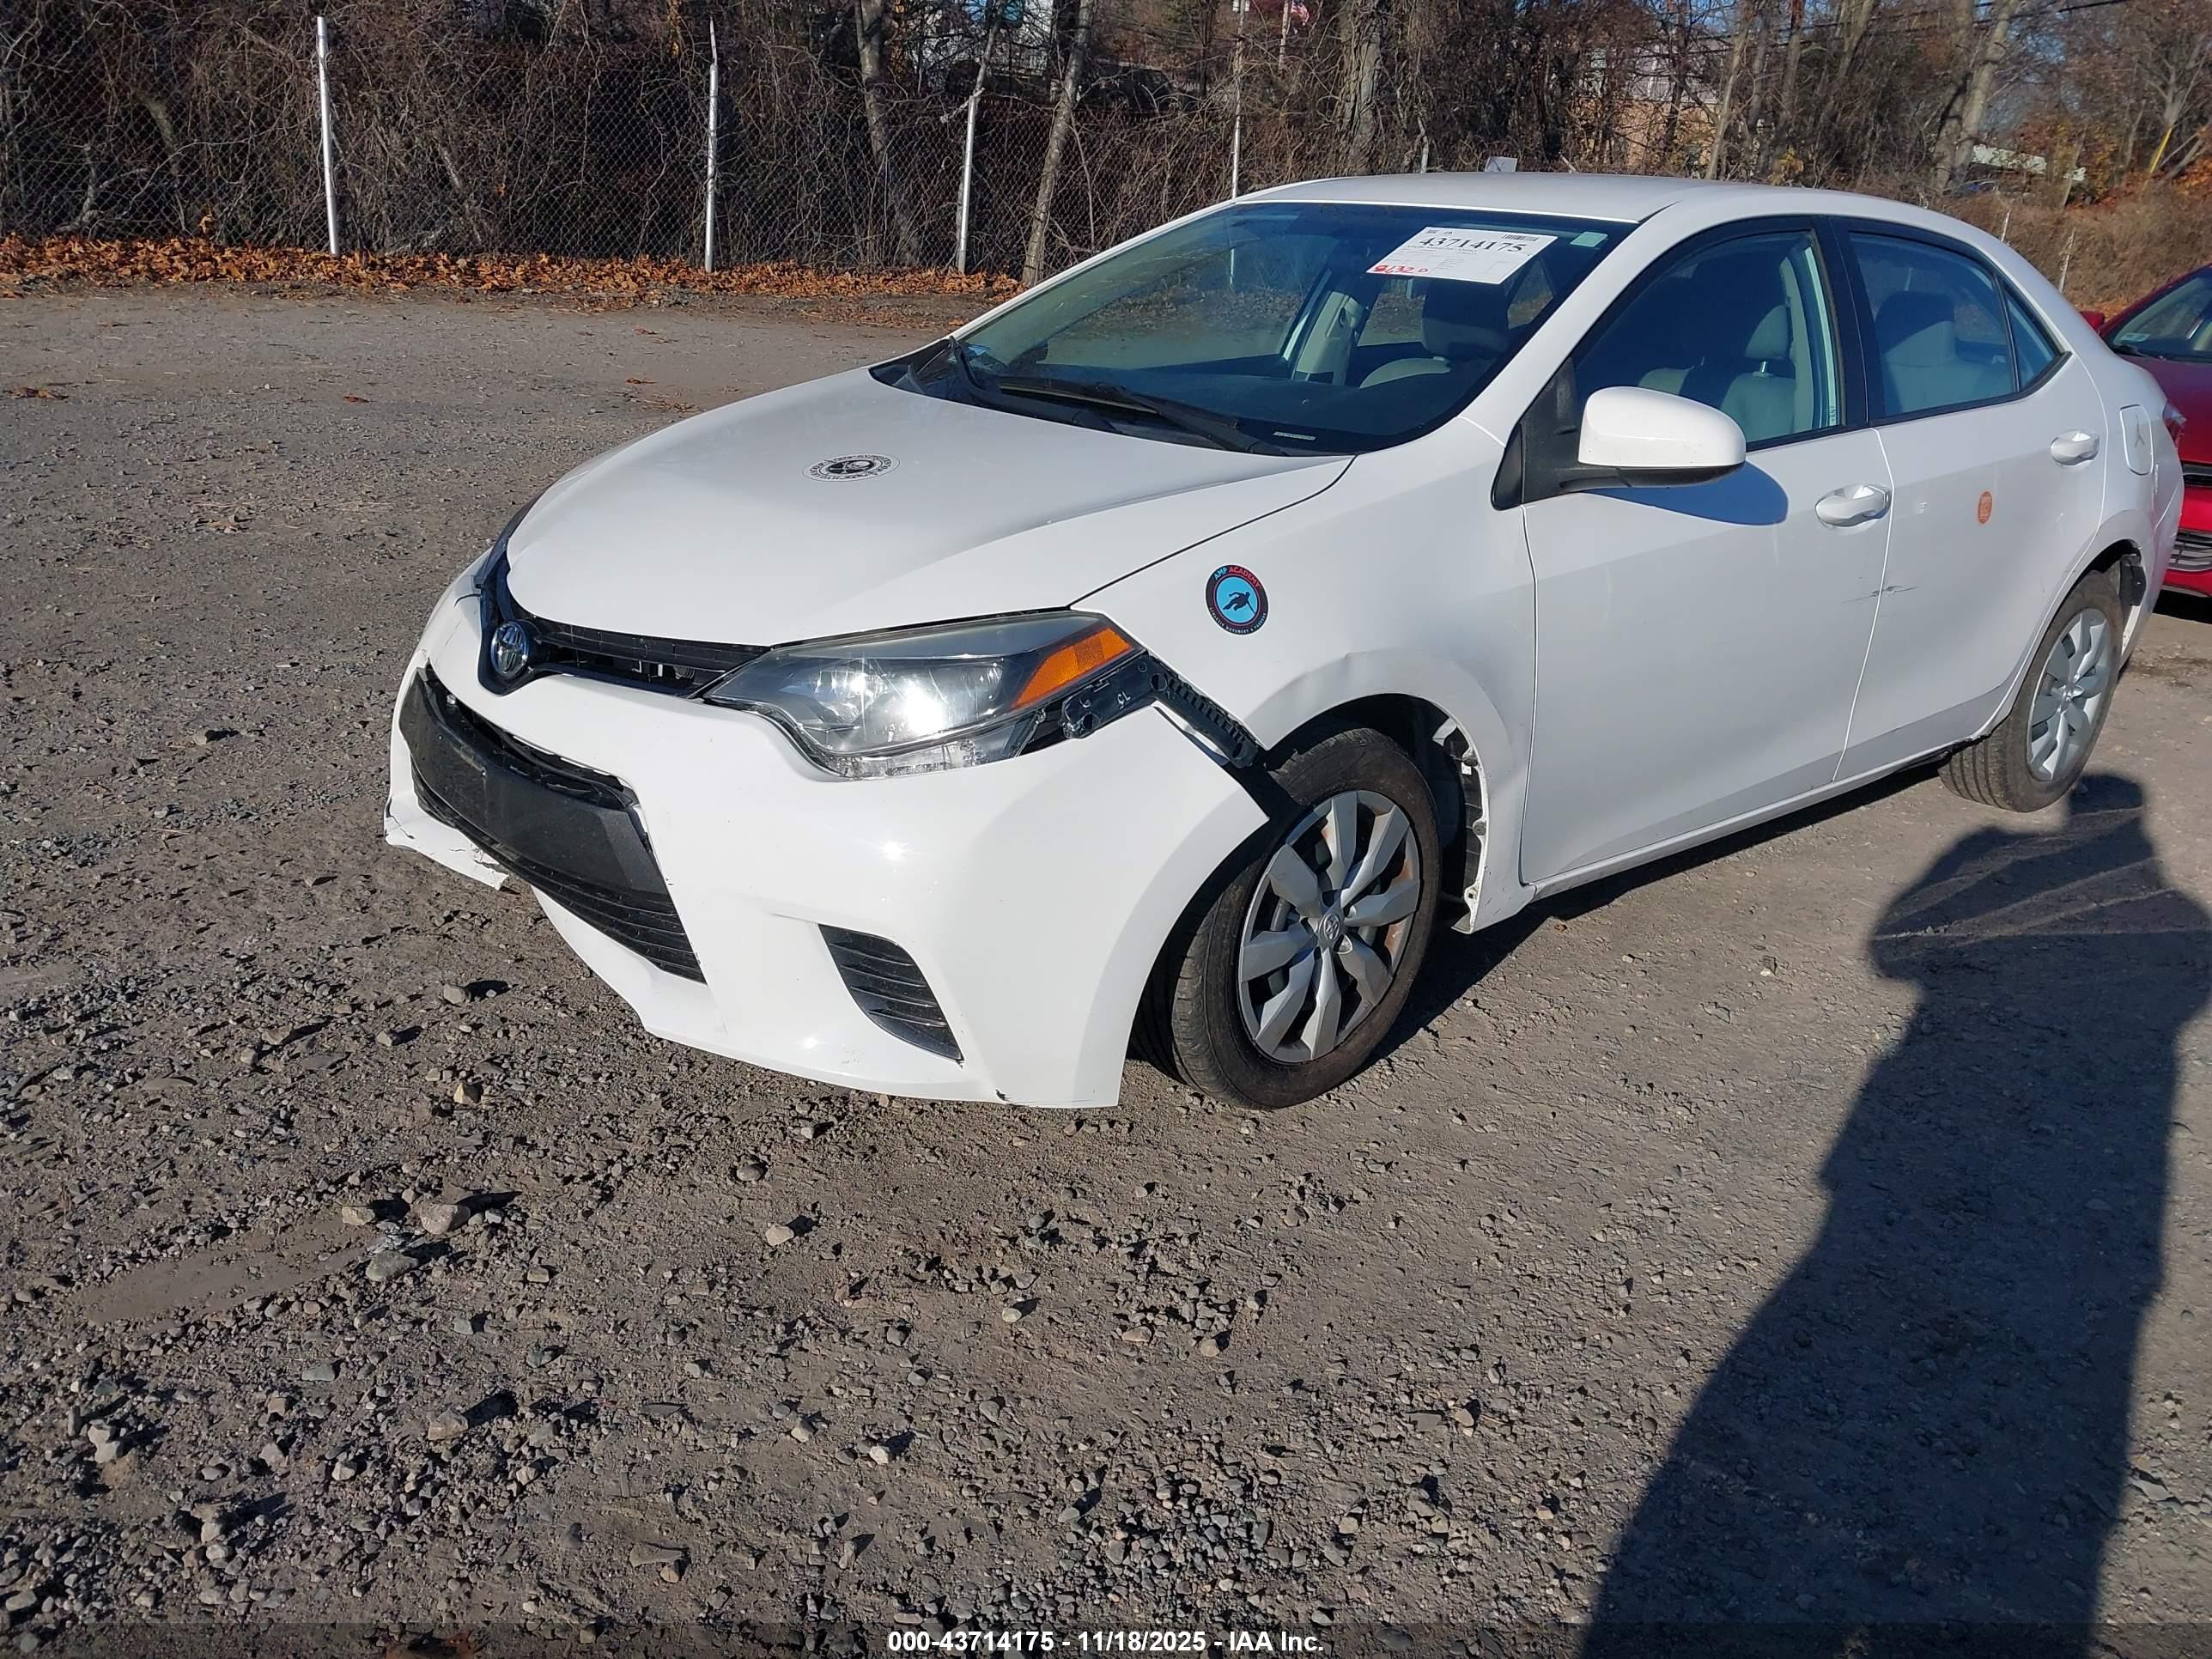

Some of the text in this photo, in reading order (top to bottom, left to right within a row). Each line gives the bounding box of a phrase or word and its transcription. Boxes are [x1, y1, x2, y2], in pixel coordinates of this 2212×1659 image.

[1419, 237, 1527, 252] 43714175
[1213, 567, 1261, 587] AMP ACADEMY
